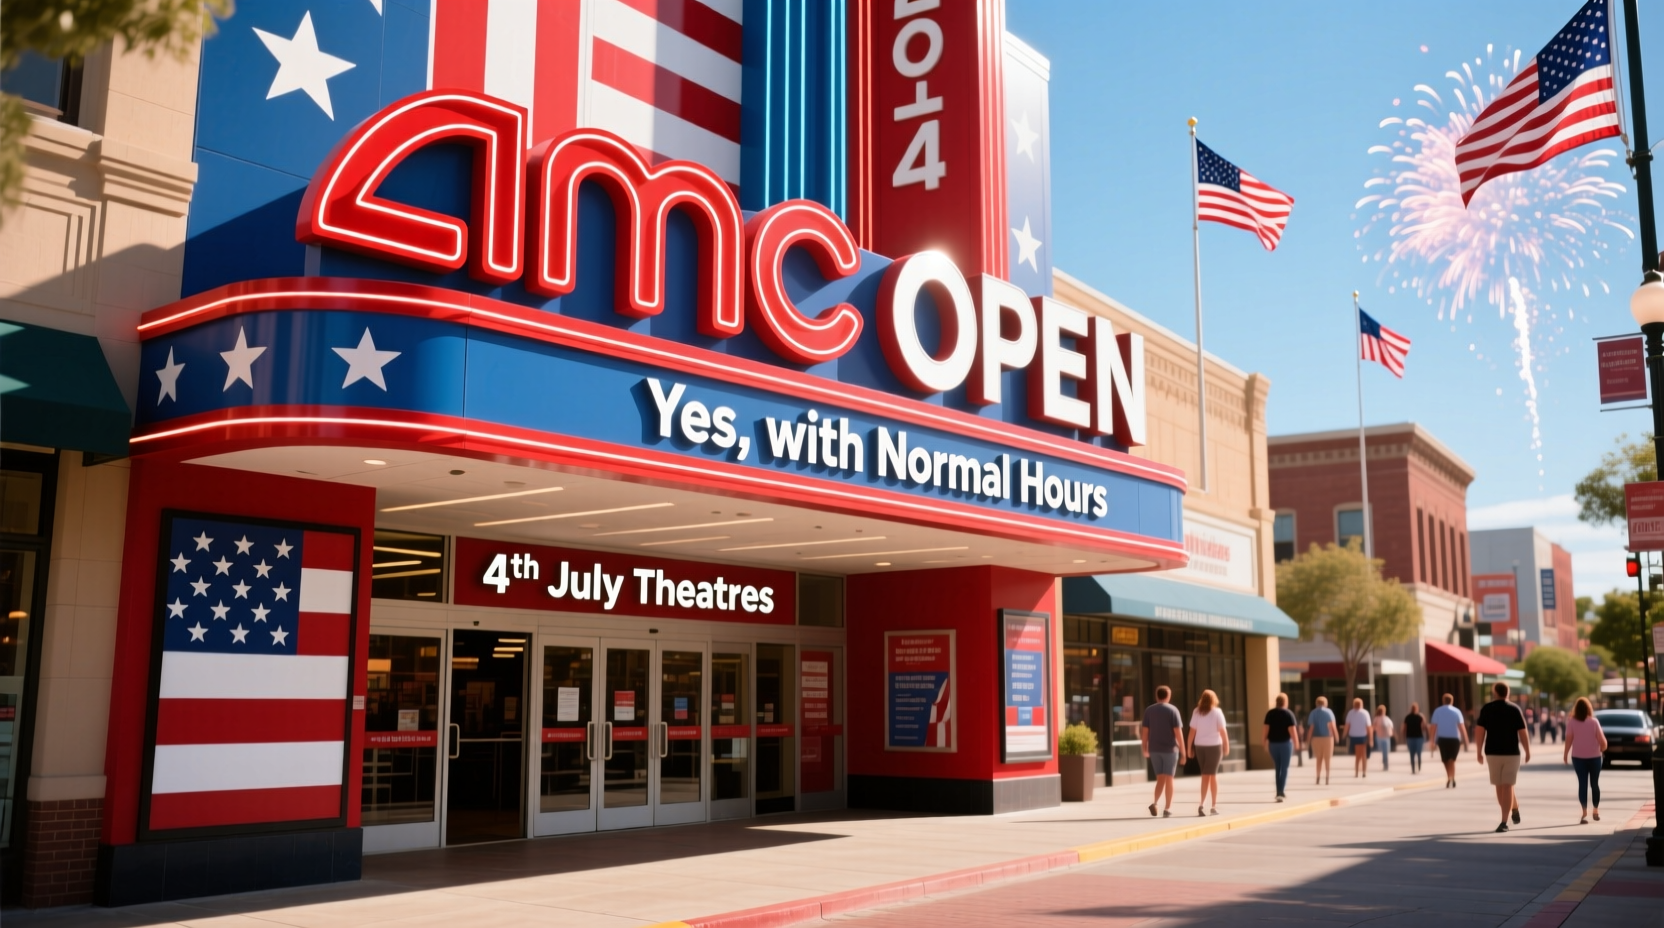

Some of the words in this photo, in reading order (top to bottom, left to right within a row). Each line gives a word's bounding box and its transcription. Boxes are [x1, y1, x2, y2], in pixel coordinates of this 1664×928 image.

[876, 249, 1146, 446] OPEN
[646, 377, 751, 462] Yes,
[765, 409, 864, 473] with
[877, 425, 1011, 500] Normal
[1020, 457, 1109, 519] Hours
[482, 553, 540, 594] 4th
[547, 561, 625, 610] July
[633, 567, 775, 614] Theatres
